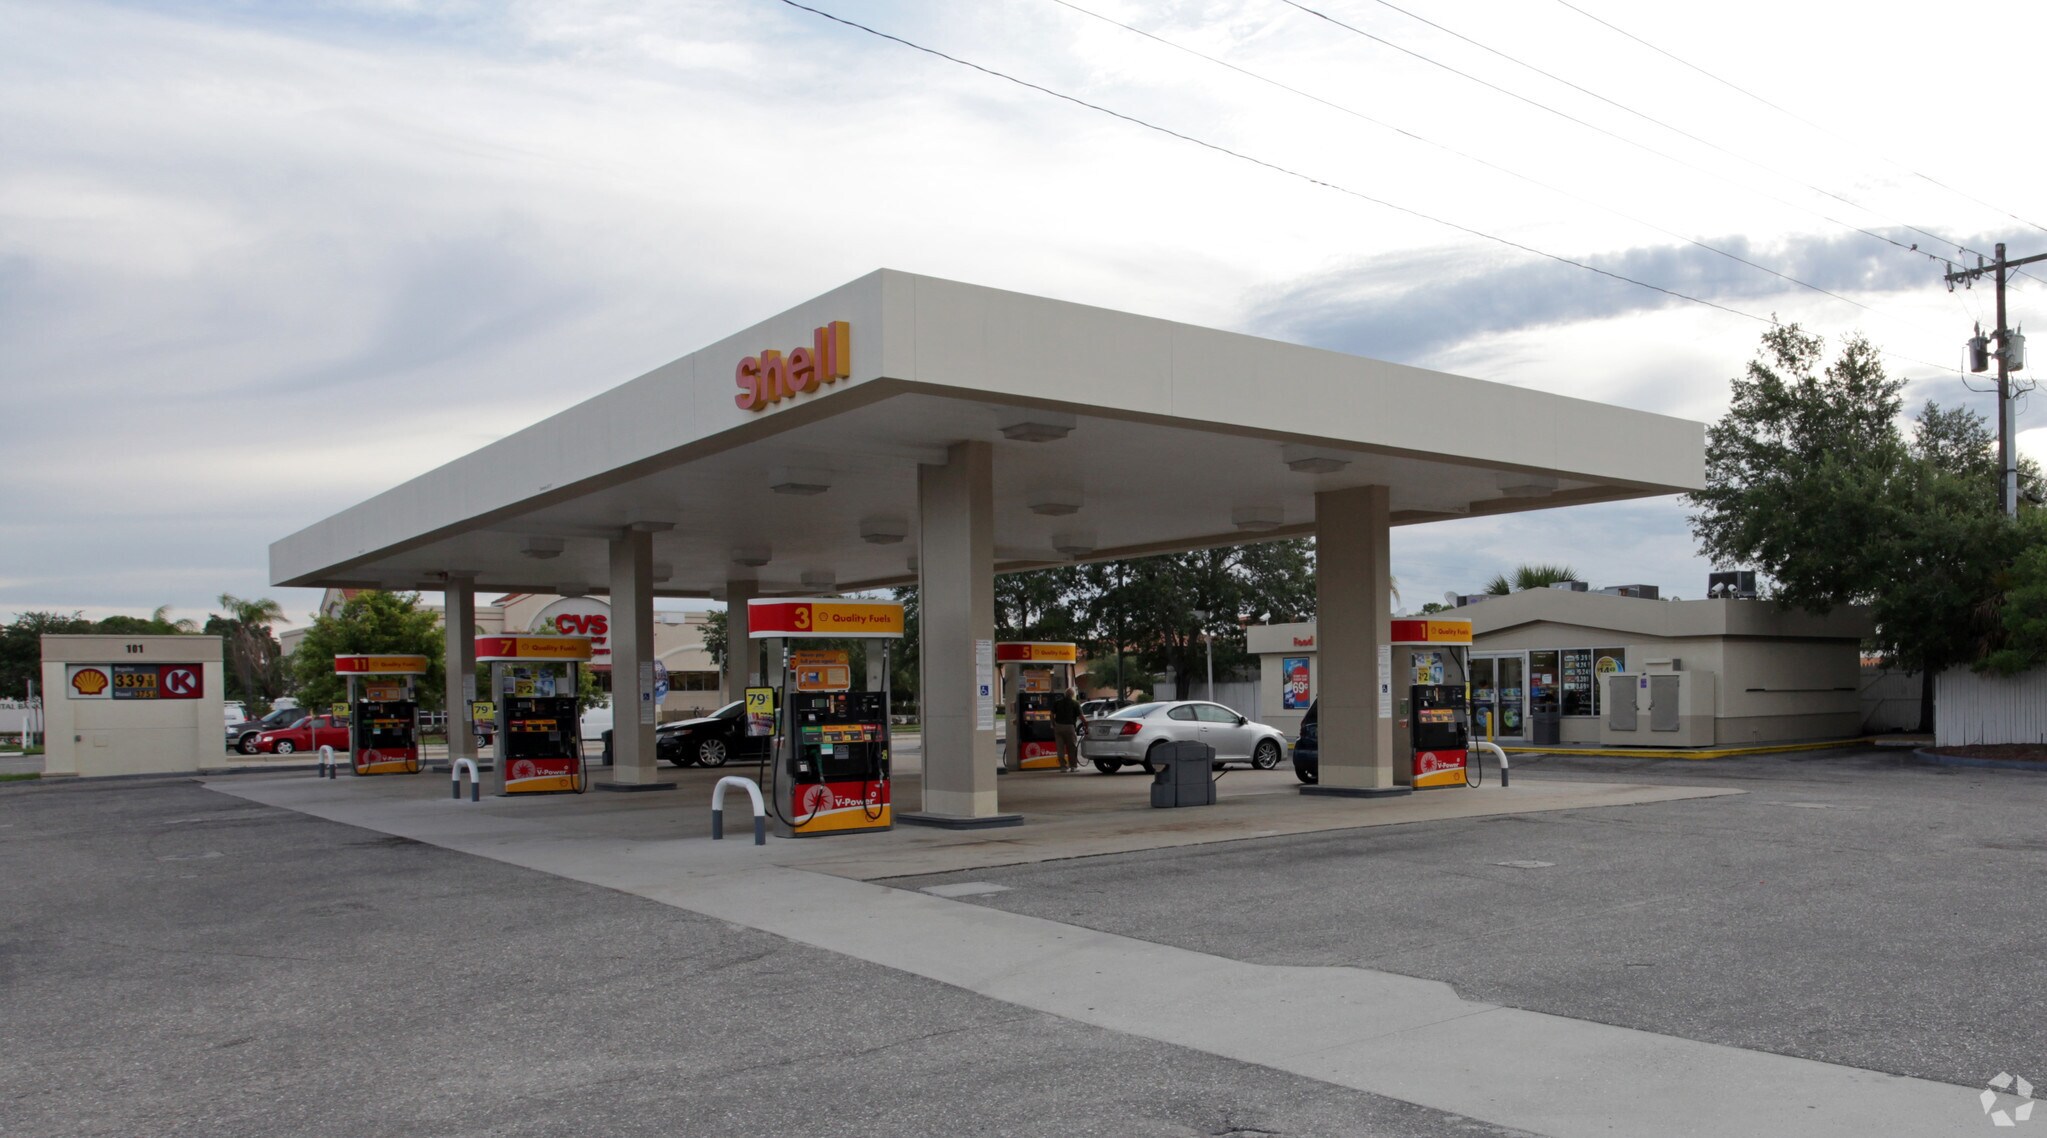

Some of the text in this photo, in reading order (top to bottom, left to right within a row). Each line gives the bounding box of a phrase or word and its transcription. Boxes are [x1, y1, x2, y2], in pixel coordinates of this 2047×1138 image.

[734, 321, 849, 411] Shell
[555, 614, 608, 635] CVS
[794, 607, 891, 629] 3 Quality Fuels
[1420, 623, 1427, 639] 1
[1438, 628, 1456, 637] Quality
[500, 640, 512, 655] 7
[1293, 636, 1313, 646] Food
[126, 645, 144, 653] 101
[1022, 646, 1030, 659] 5
[353, 659, 366, 670] 11
[115, 674, 145, 687] 339
[1437, 761, 1459, 769] V-Power
[835, 798, 876, 806] V-Power
